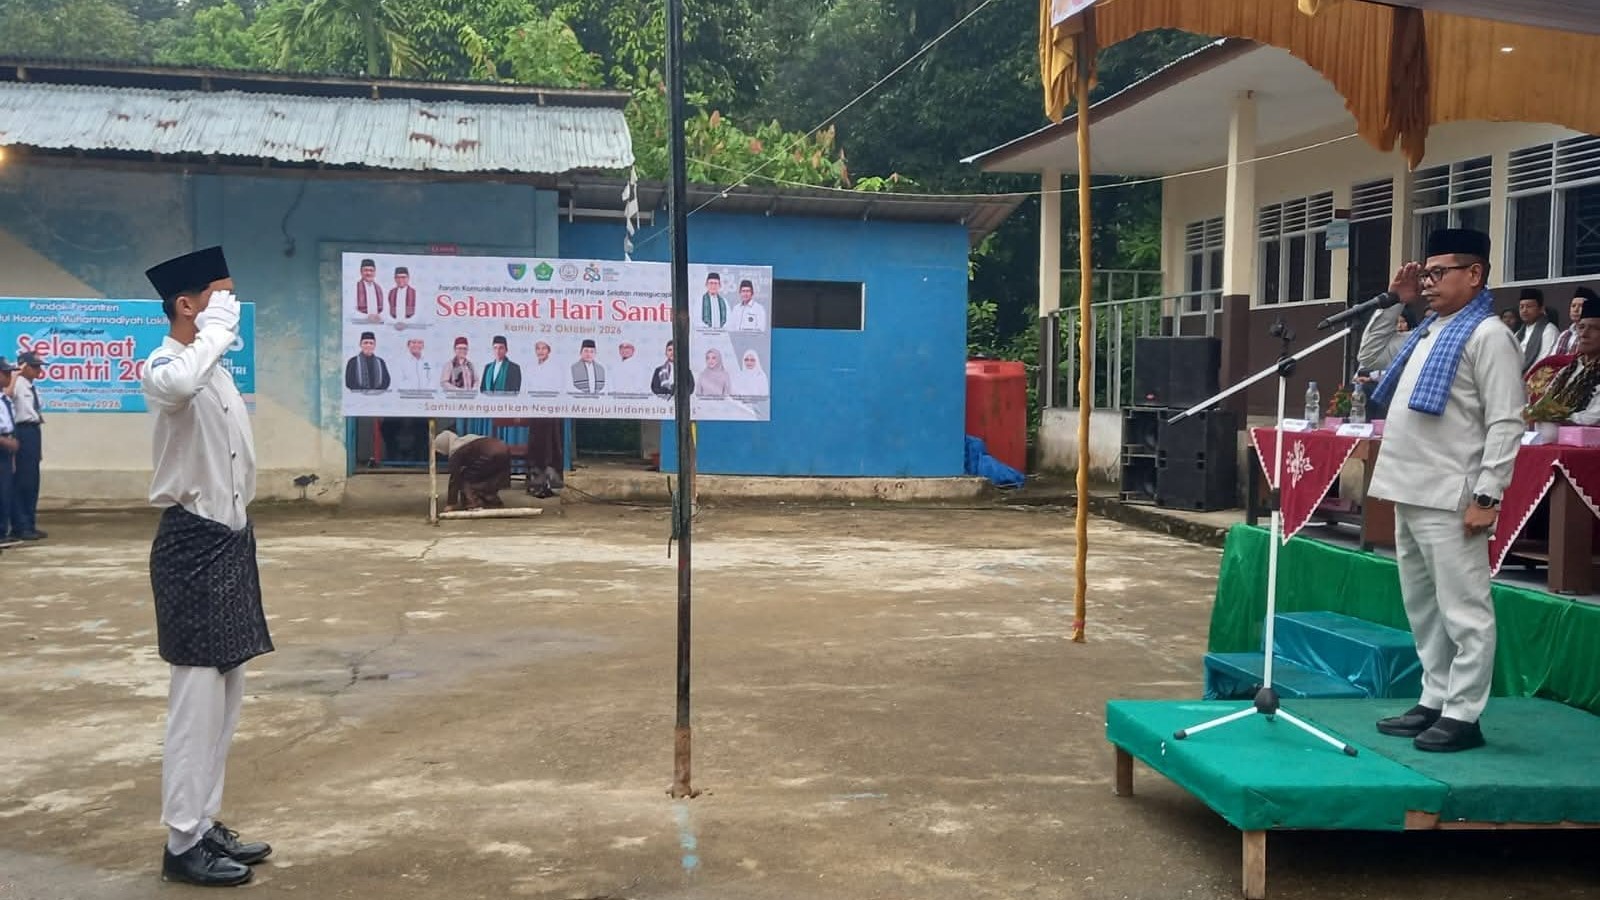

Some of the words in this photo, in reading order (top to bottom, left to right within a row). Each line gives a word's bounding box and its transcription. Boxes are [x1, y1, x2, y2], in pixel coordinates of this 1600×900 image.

[633, 291, 672, 299] mengucap
[30, 302, 66, 310] Pondok
[72, 303, 119, 311] Pesantren
[436, 294, 540, 318] Selamat
[548, 297, 603, 320] Hari
[611, 299, 673, 322] Sant
[13, 315, 58, 323] Hasanah
[62, 315, 144, 326] Muhammadiyah
[540, 324, 552, 333] 22
[555, 324, 596, 333] Oktober
[18, 335, 134, 358] Selamat
[119, 360, 145, 380] 20
[458, 402, 529, 413] Menguatkan
[532, 403, 568, 414] Negeri
[571, 404, 611, 415] Menuju
[614, 405, 666, 415] Indonesia
